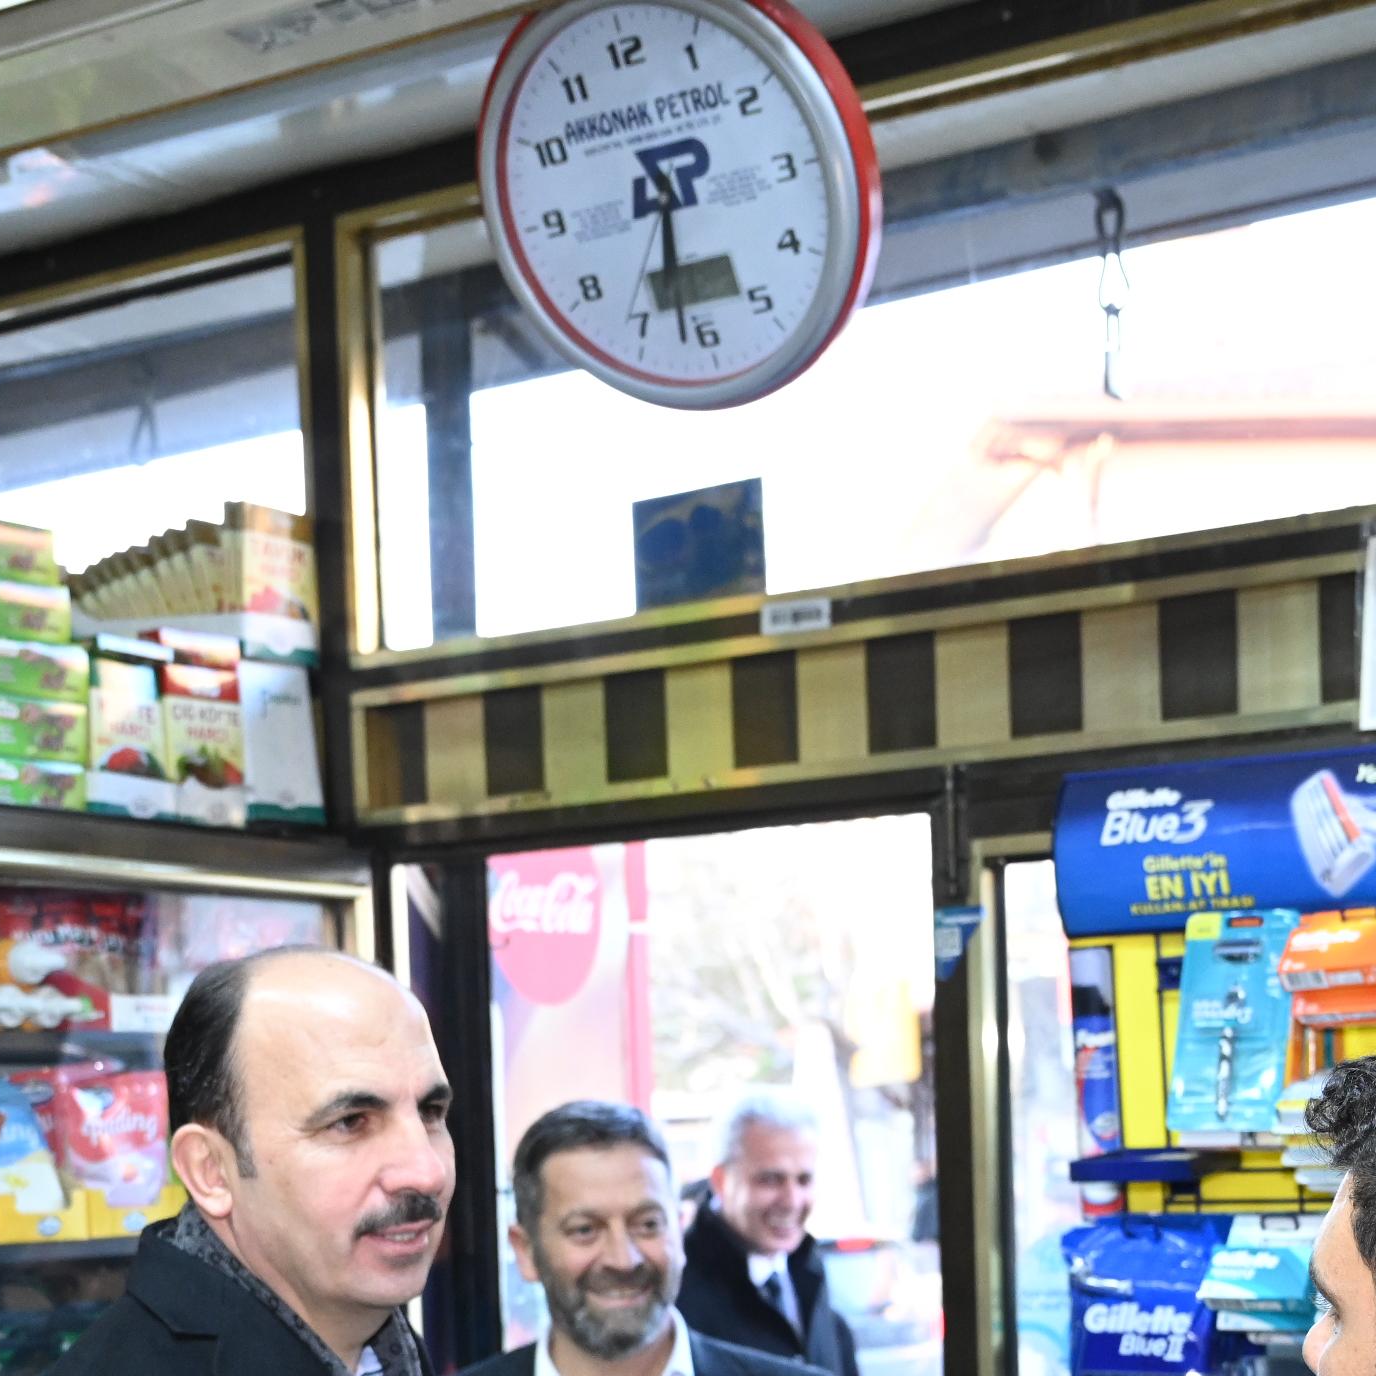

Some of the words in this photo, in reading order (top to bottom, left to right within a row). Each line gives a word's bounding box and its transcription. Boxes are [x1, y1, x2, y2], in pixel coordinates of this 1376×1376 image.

[606, 35, 646, 70] 12
[683, 44, 699, 72] 1
[561, 74, 589, 104] 11
[735, 86, 763, 117] 2
[564, 111, 653, 144] AKKONAK
[655, 82, 731, 124] PETROL
[534, 137, 569, 169] 10
[771, 153, 798, 184] 3
[542, 209, 567, 239] 9
[777, 229, 802, 256] 4
[578, 274, 603, 303] 8
[747, 286, 775, 315] 5
[629, 312, 650, 339] 7
[694, 319, 721, 349] 6
[1106, 787, 1183, 811] Gillette
[1100, 799, 1215, 847] Blue3
[1143, 851, 1228, 874] Gillette'in
[1145, 873, 1185, 901] EN
[1190, 868, 1232, 898] İYİ
[1083, 1301, 1192, 1335] Gillette
